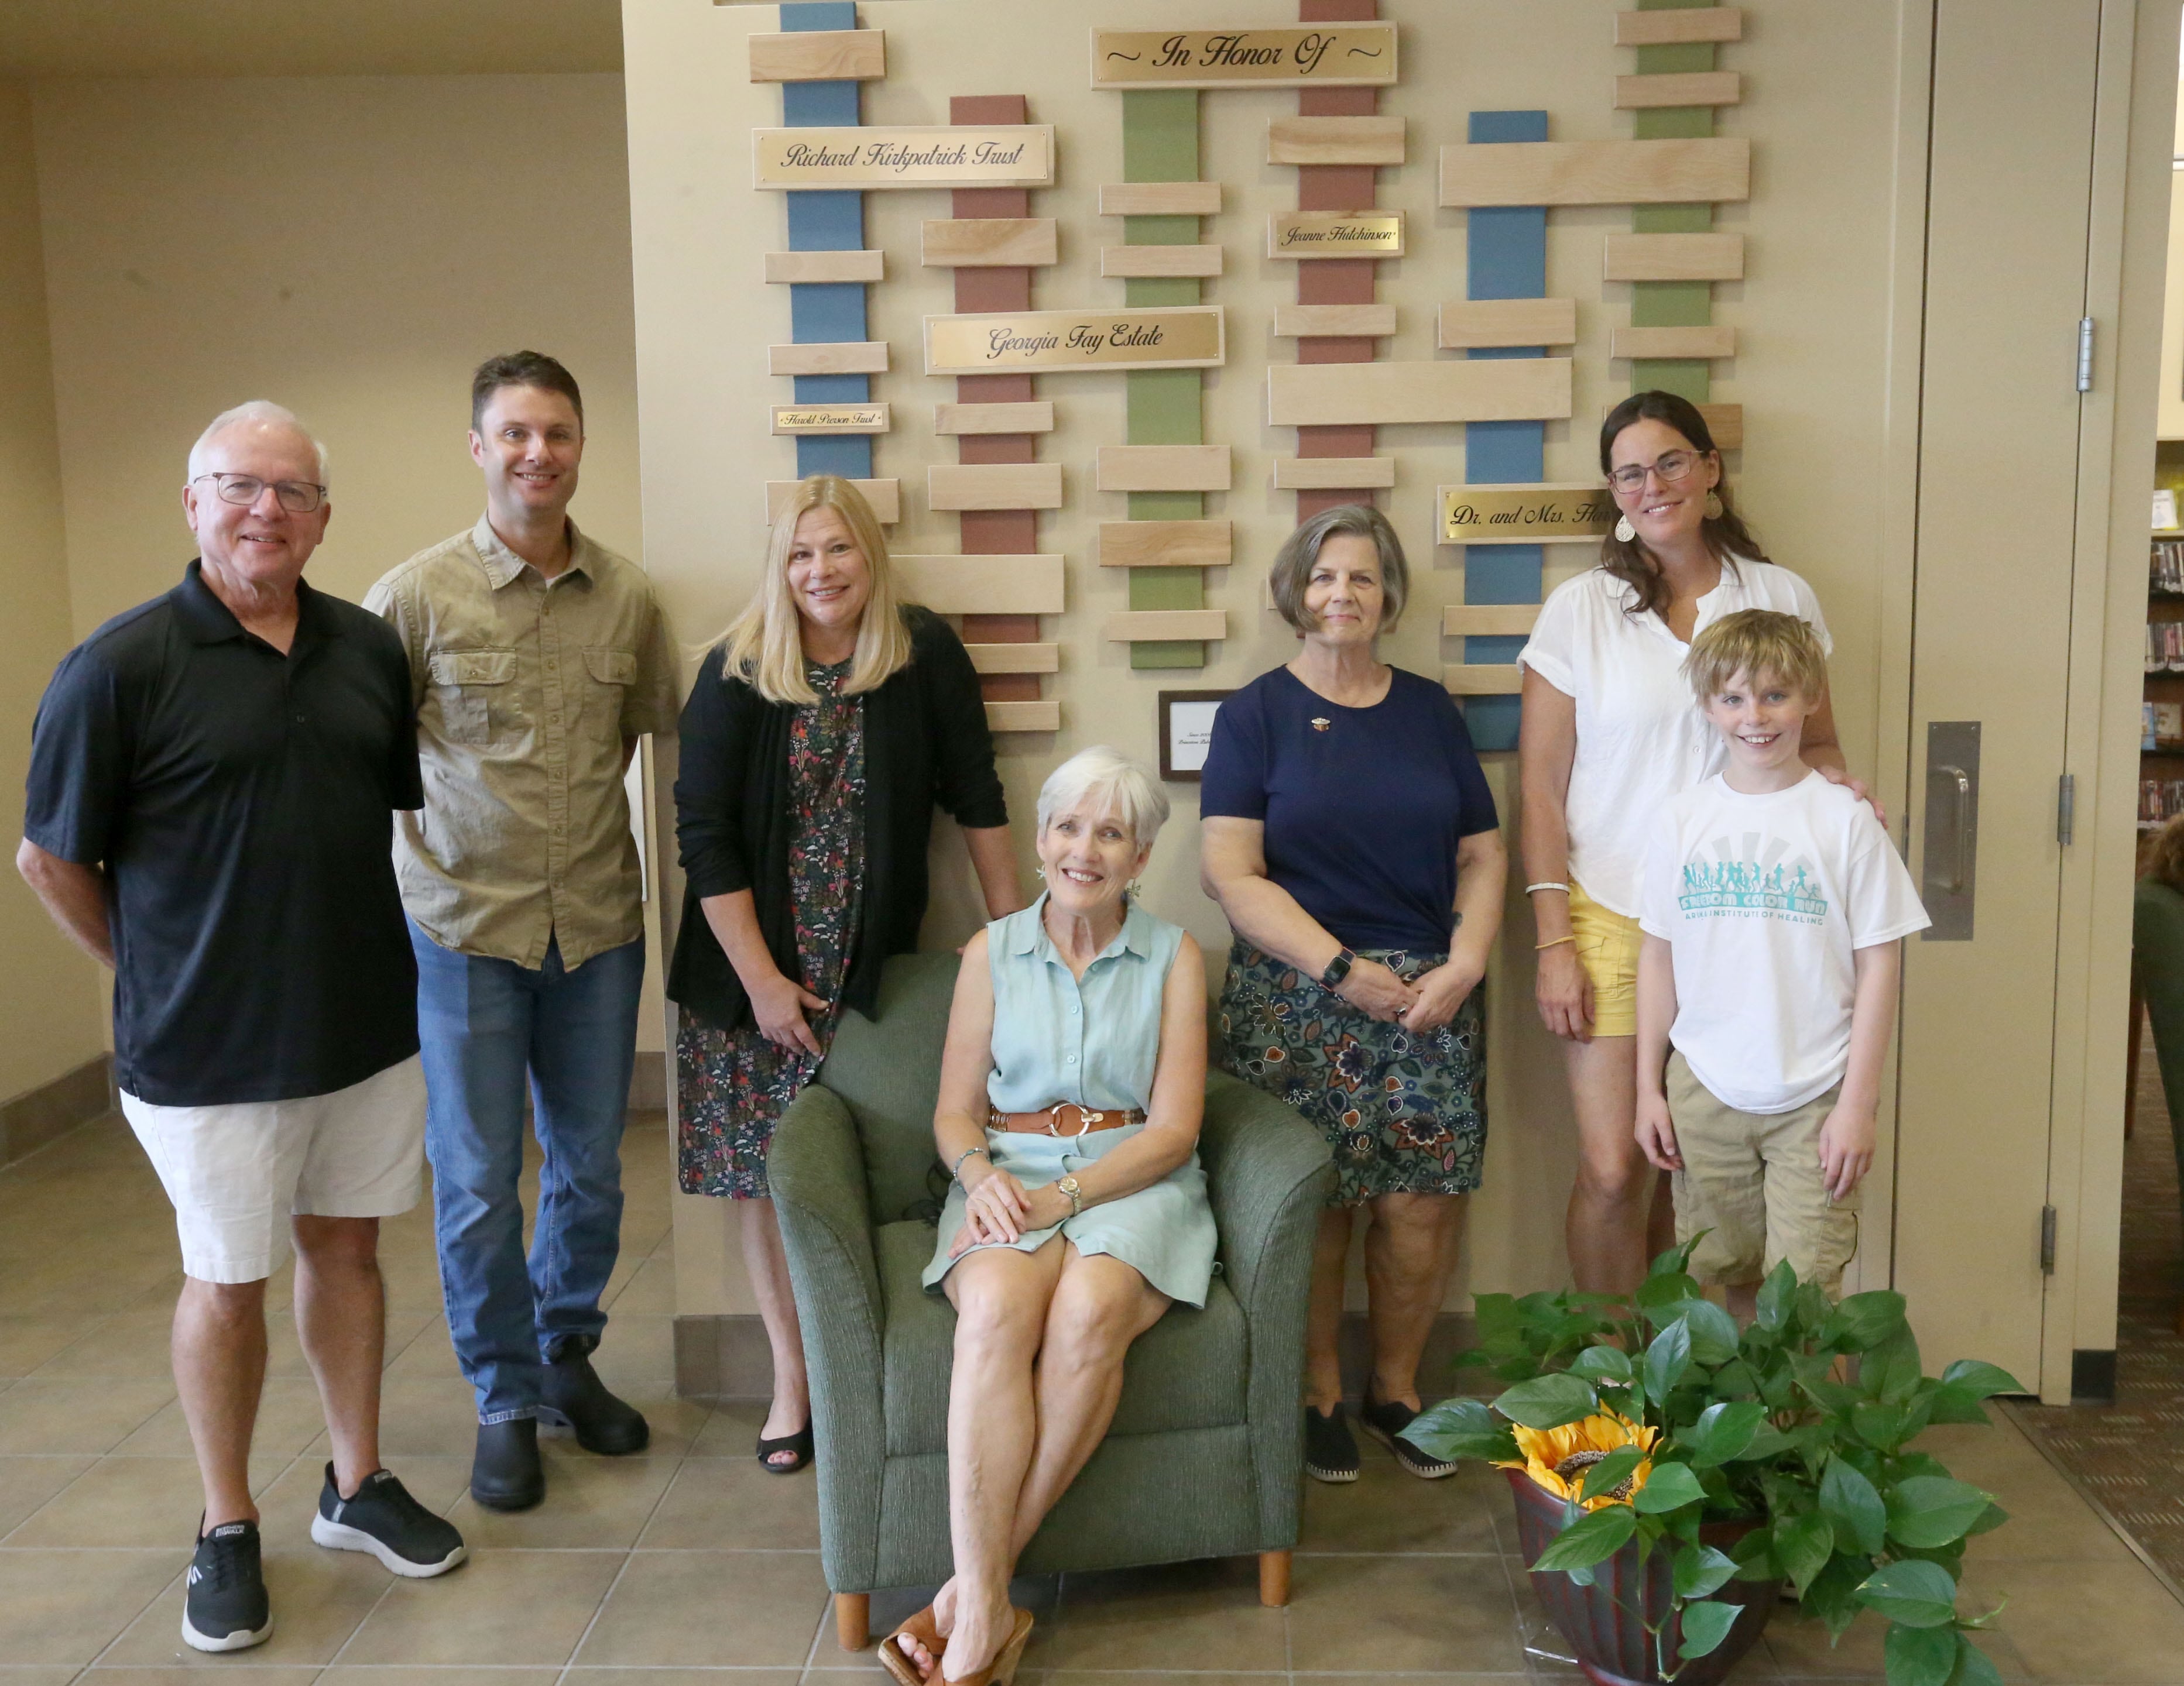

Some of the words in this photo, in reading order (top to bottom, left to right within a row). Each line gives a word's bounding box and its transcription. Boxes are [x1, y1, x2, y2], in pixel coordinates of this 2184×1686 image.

[1152, 35, 1191, 67] In
[1199, 34, 1282, 67] Honor
[1294, 33, 1336, 74] Of
[780, 143, 860, 167] Richard
[862, 142, 967, 173] Kirkpatrick
[972, 142, 1024, 166] Trust
[1281, 226, 1325, 246] Jeanne
[1328, 226, 1393, 241] Hutchinson
[987, 328, 1058, 359] Georgia
[1066, 325, 1104, 355] Fay
[1109, 324, 1163, 346] Estate
[784, 414, 817, 425] Harold
[852, 413, 876, 423] Trust
[1451, 505, 1481, 524] Dr.
[1490, 506, 1523, 524] and
[1524, 503, 1565, 524] Mrs.
[1743, 894, 1788, 909] COLOR
[1795, 899, 1825, 915] RUN
[1778, 913, 1823, 926] HEALING
